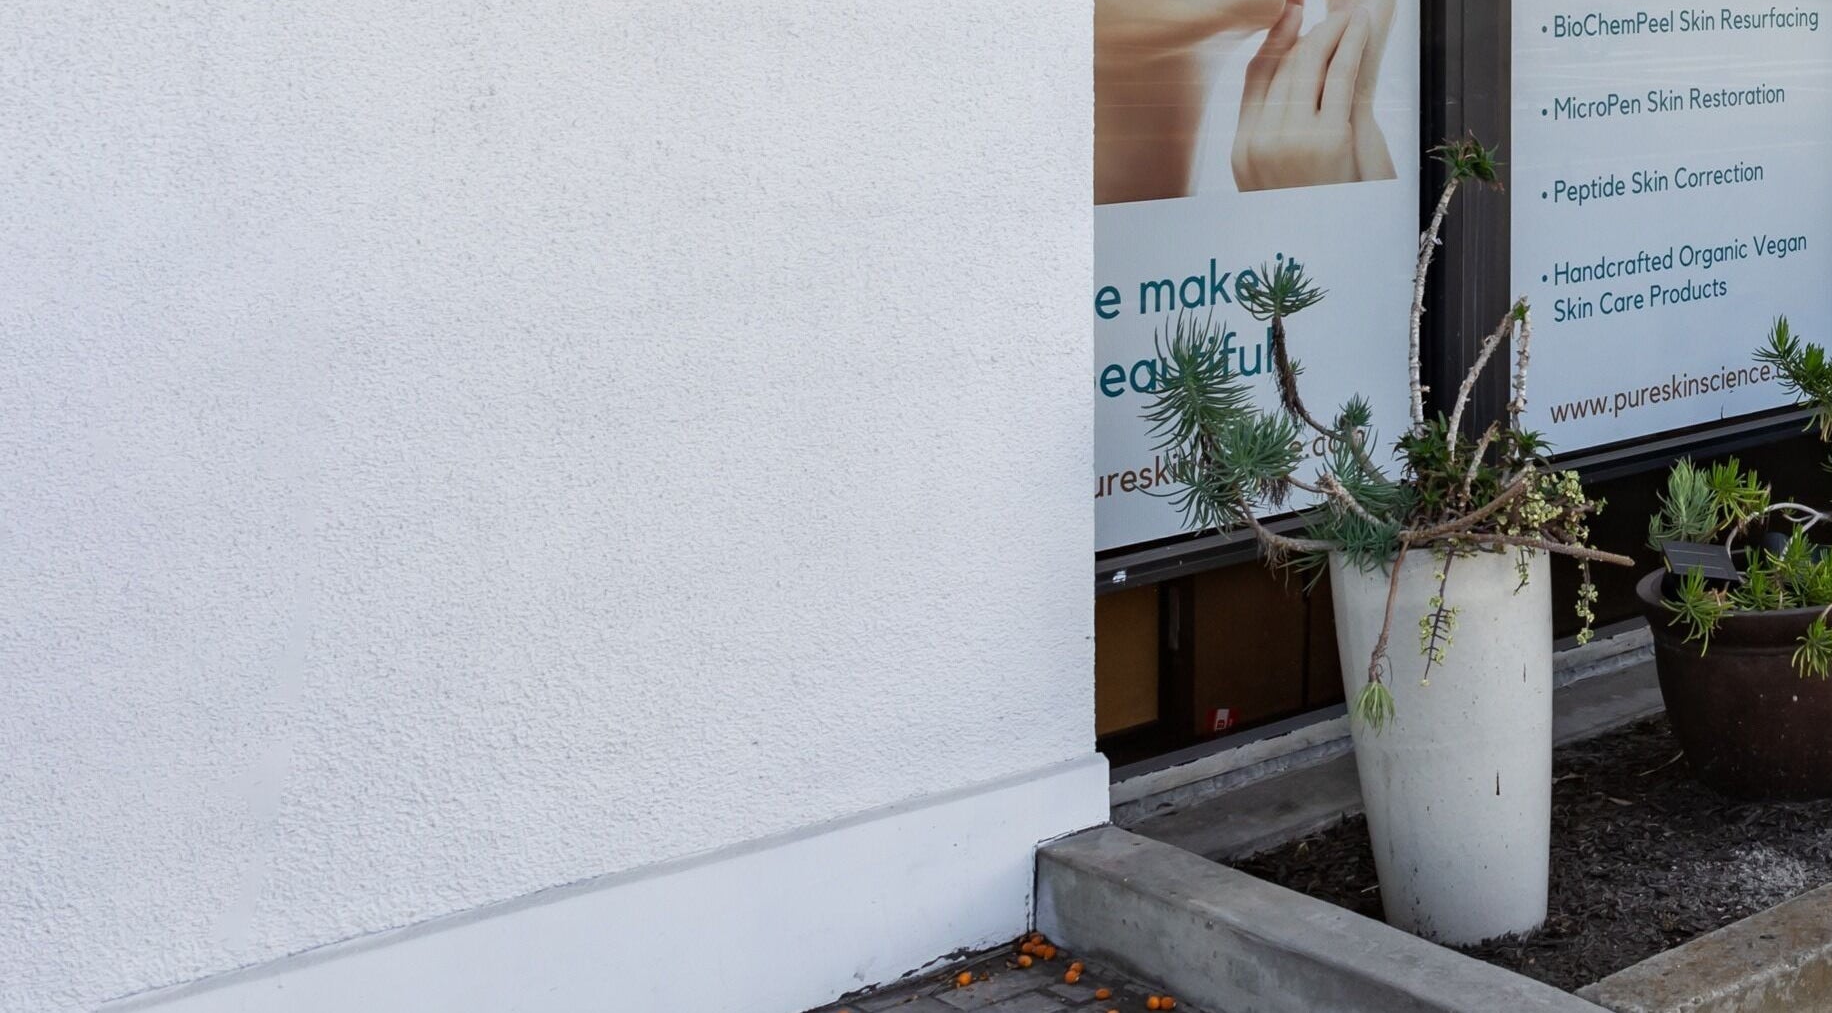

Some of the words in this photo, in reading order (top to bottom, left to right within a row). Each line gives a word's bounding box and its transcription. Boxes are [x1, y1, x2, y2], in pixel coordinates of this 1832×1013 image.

[1554, 10, 1673, 38] BioChemPeel
[1680, 9, 1715, 31] Skin
[1721, 6, 1819, 32] Resurfacing
[1554, 93, 1641, 120] MicroPen
[1647, 90, 1683, 112] Skin
[1690, 84, 1785, 110] Restoration
[1554, 174, 1625, 205] Peptide
[1632, 170, 1668, 194] Skin
[1675, 162, 1764, 189] Correction
[1554, 247, 1673, 286] Handcrafted
[1679, 239, 1748, 270] Organic
[1753, 235, 1807, 258] Vegan
[1140, 258, 1259, 315] make
[1554, 298, 1593, 322] Skin
[1600, 290, 1644, 315] Care
[1650, 278, 1727, 307] Products
